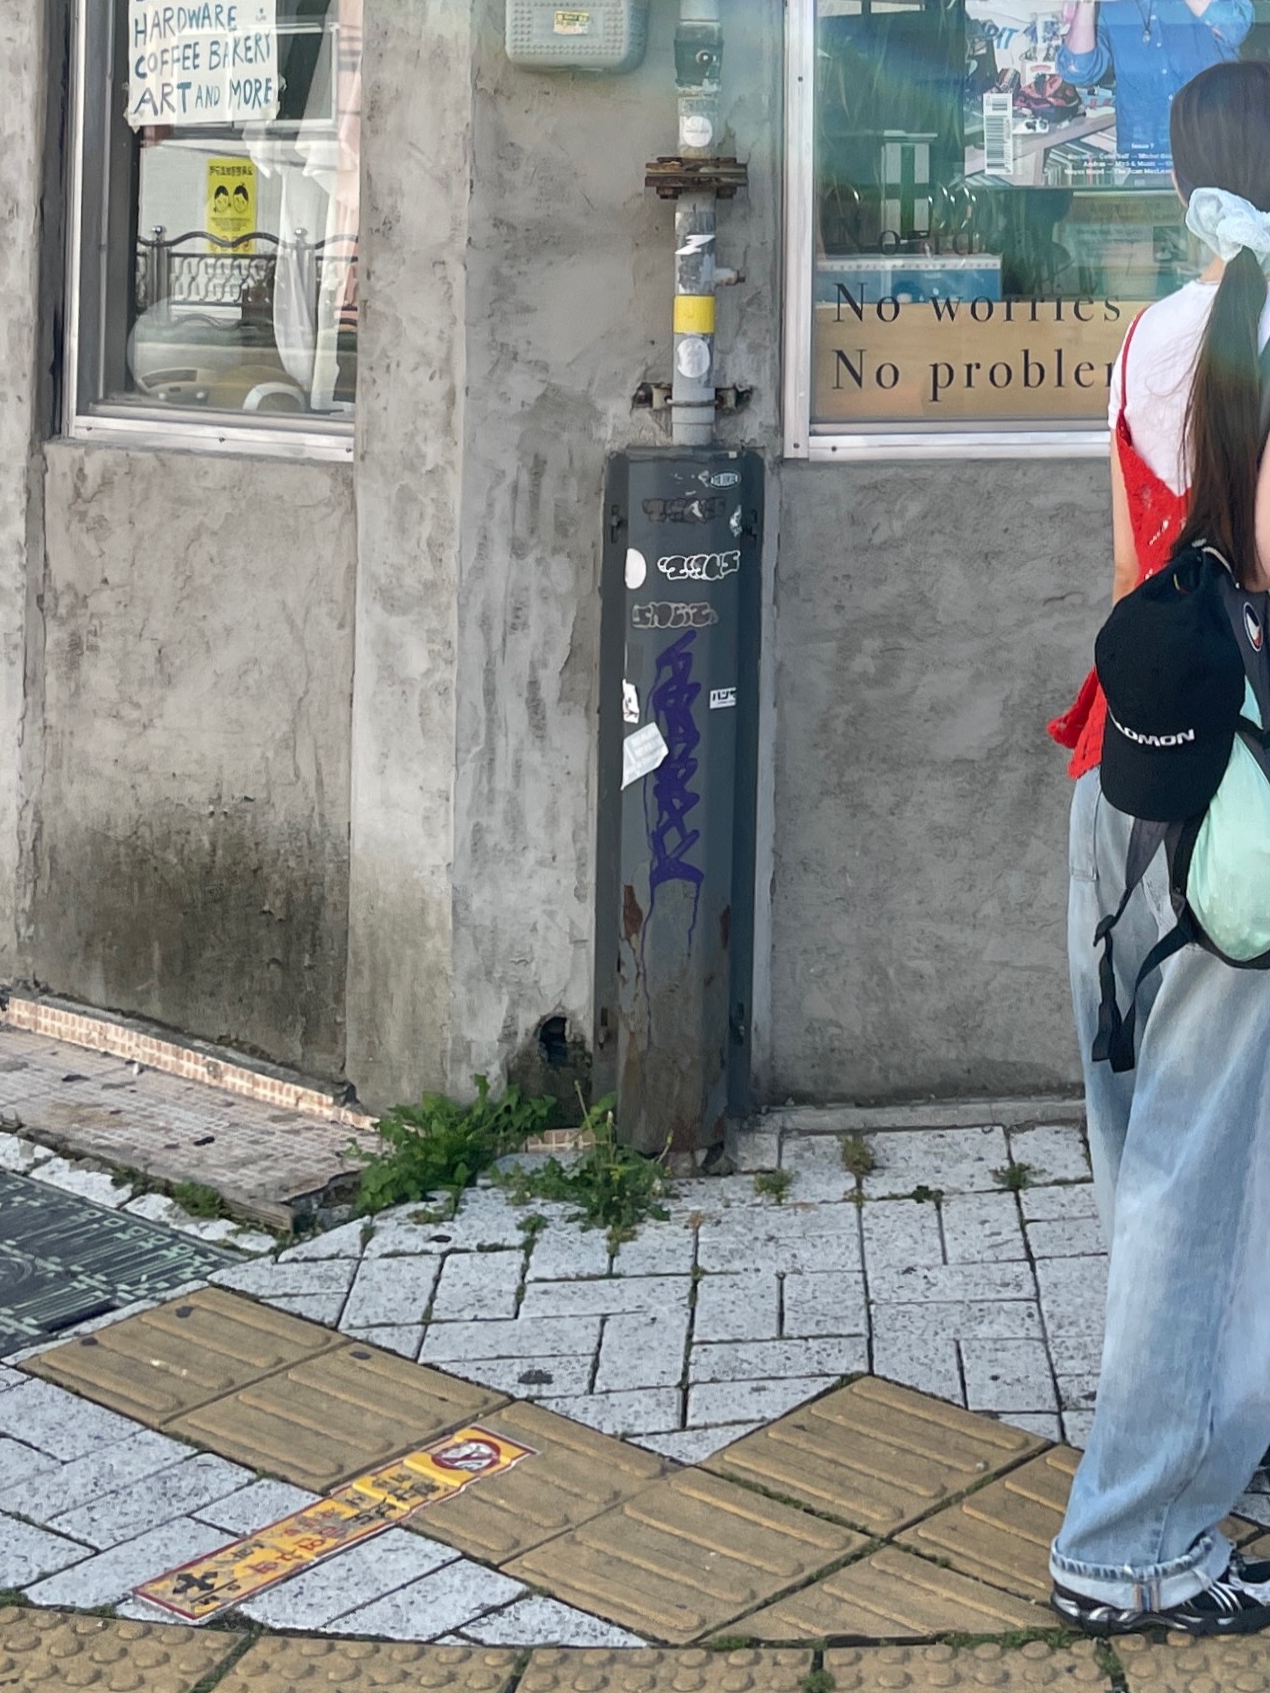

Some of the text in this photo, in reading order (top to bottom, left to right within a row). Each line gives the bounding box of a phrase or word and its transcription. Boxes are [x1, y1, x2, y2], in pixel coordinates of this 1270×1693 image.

[134, 2, 238, 48] HARDWARE
[135, 29, 272, 79] COFFEE BAKERY
[133, 77, 272, 116] ART AND MORE
[832, 282, 1121, 323] No worries
[832, 348, 900, 390] No
